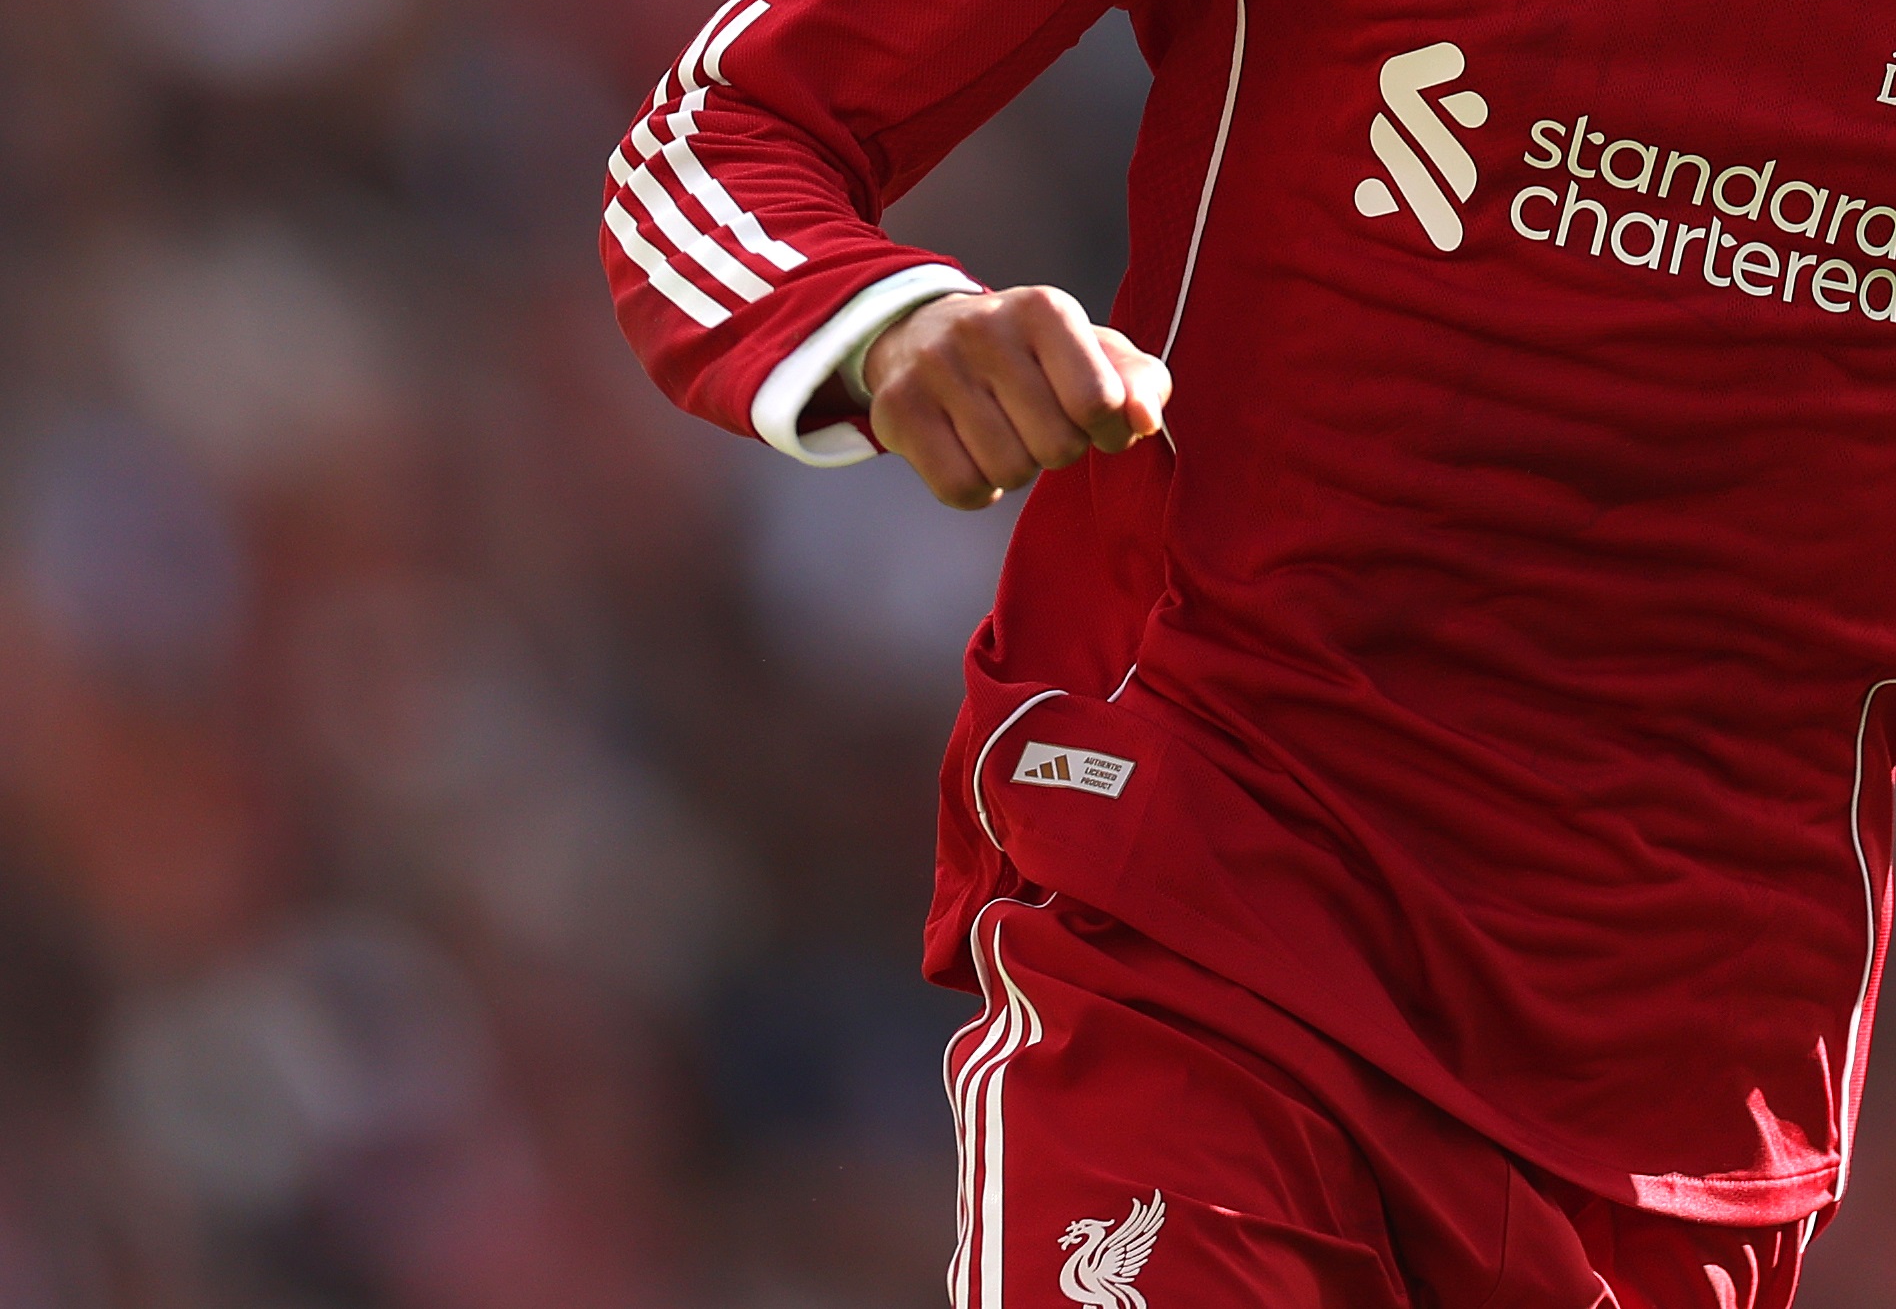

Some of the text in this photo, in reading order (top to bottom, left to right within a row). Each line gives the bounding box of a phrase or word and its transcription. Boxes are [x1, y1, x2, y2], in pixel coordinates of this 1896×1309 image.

[1084, 756, 1122, 772] AUTHENTIC
[1085, 767, 1117, 781] LICENSED
[1081, 777, 1113, 790] PRODUCT
